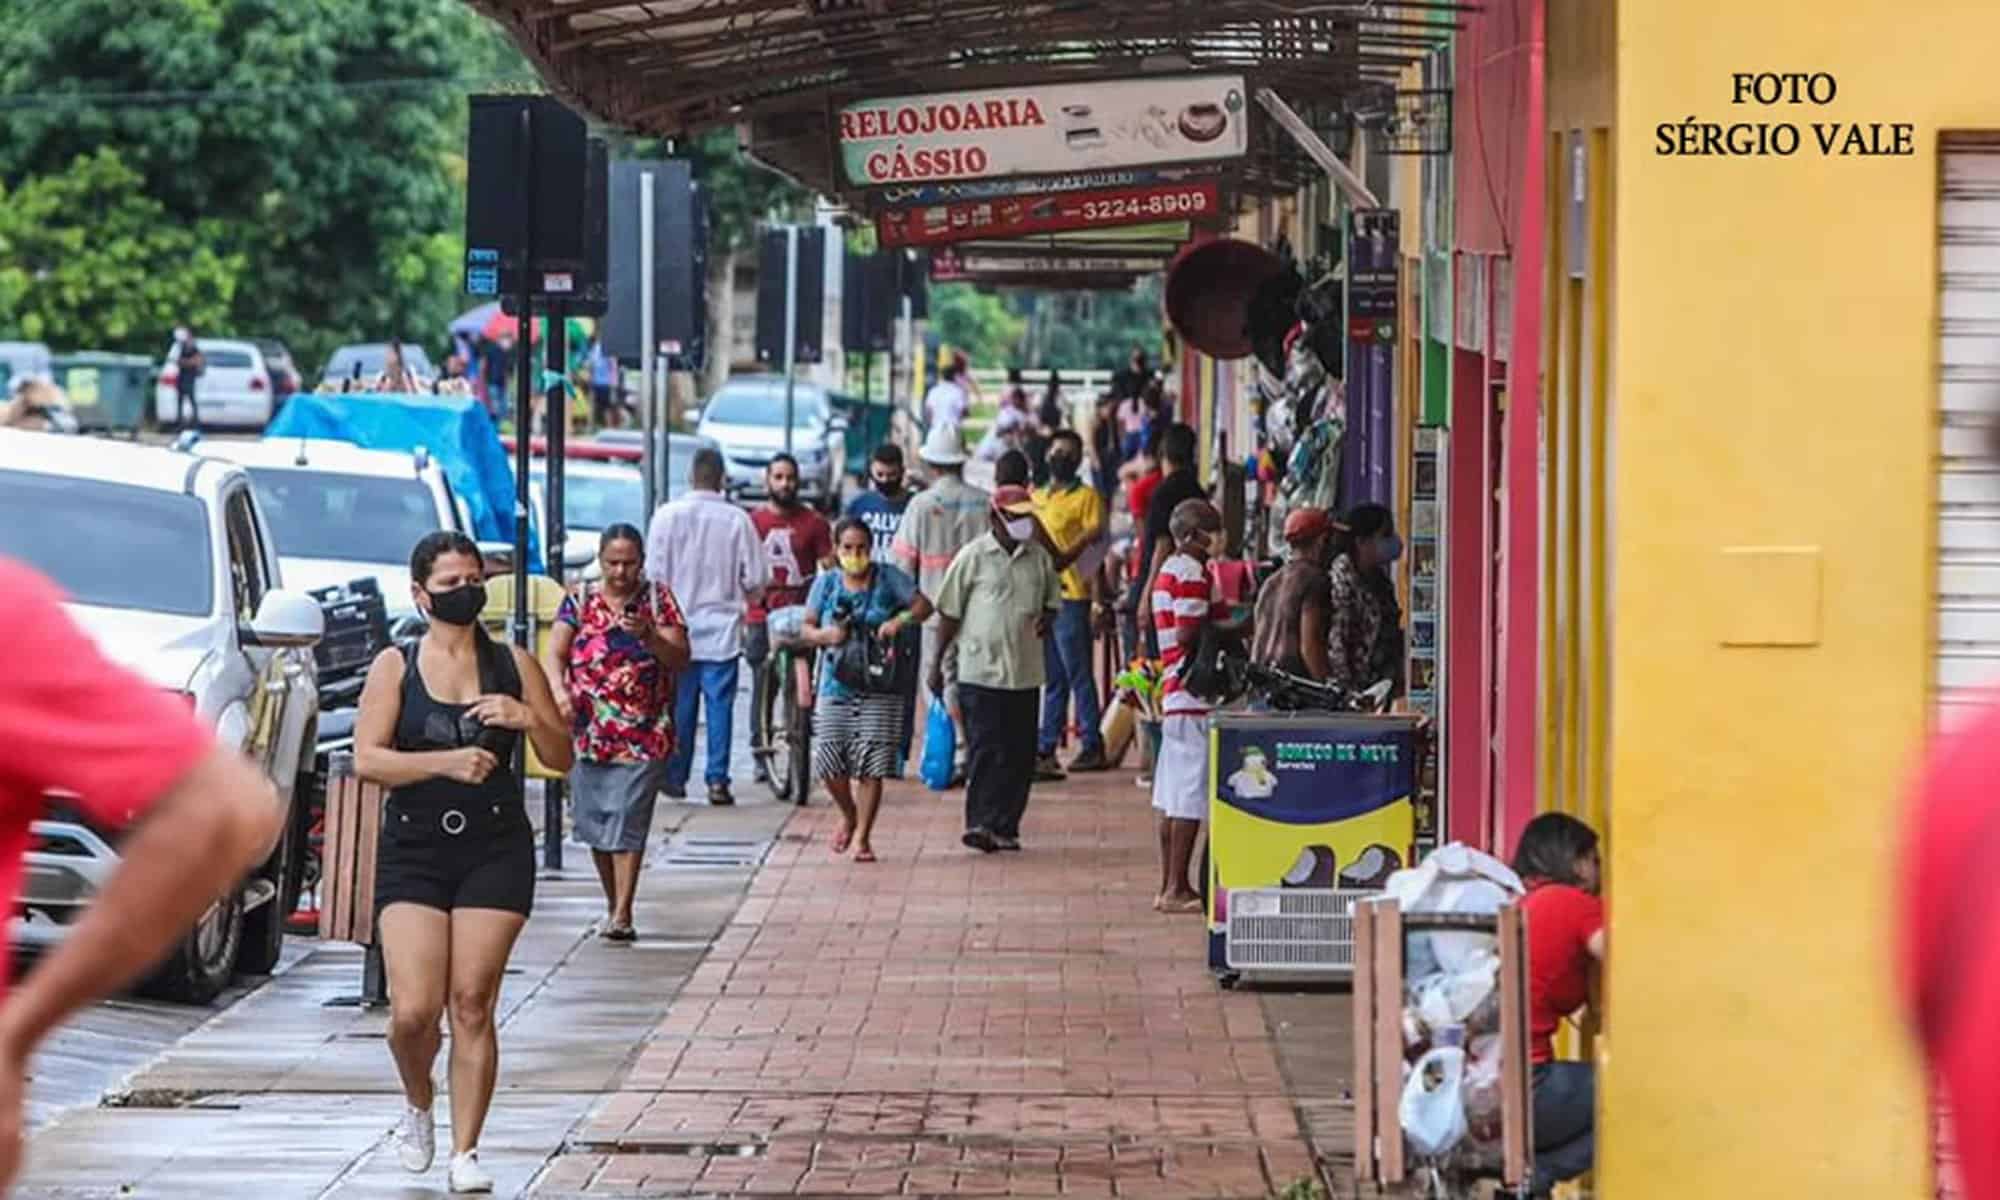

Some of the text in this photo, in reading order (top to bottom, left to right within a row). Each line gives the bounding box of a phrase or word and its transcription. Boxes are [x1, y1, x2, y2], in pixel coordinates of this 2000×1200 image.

[839, 98, 1045, 140] RELOJOARIA
[867, 143, 987, 180] CÁSSIO
[1336, 743, 1356, 761] DE
[1360, 743, 1399, 763] NEVE
